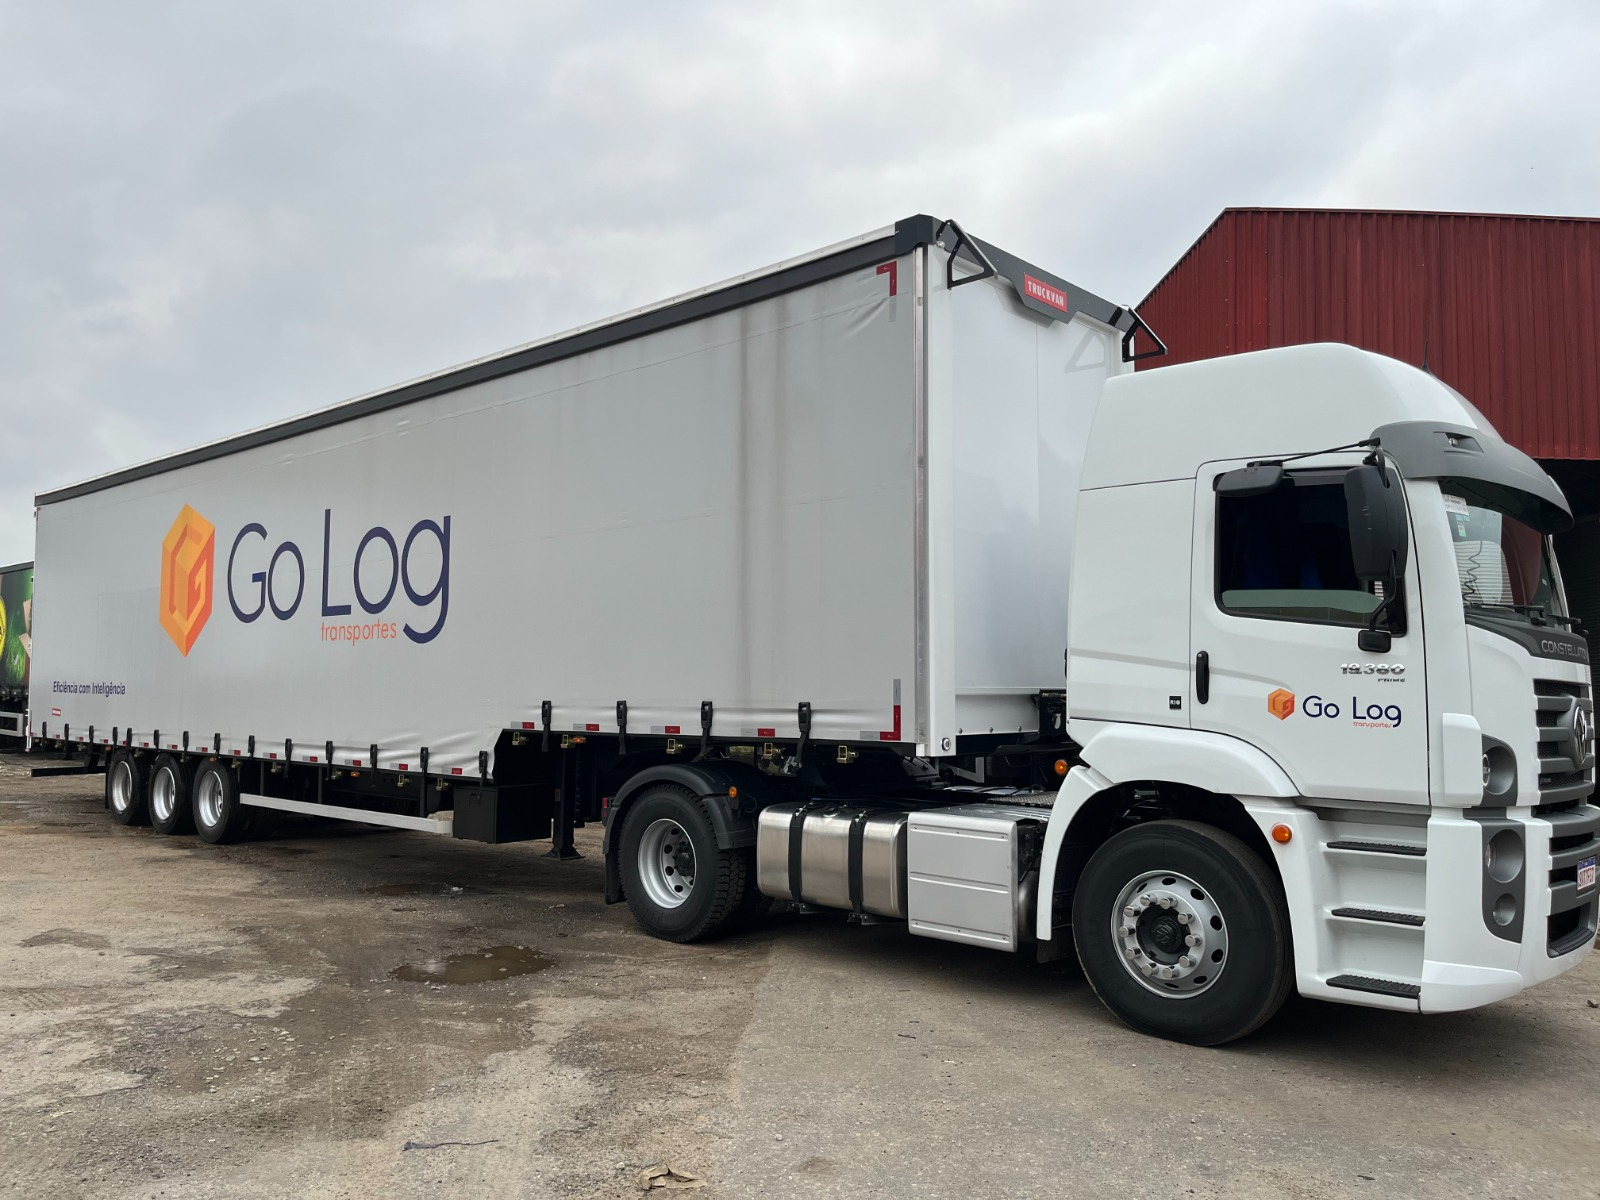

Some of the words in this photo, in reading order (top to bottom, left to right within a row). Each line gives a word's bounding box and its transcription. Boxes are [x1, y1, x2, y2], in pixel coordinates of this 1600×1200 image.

[1027, 280, 1064, 307] TRUCKVAN
[227, 522, 305, 624] Go
[321, 508, 451, 644] Log
[321, 618, 397, 647] transportes
[53, 681, 78, 693] Eficiência
[79, 684, 91, 694] com
[92, 682, 126, 698] Inteligência
[1302, 695, 1340, 718] Go
[1352, 696, 1402, 728] Log
